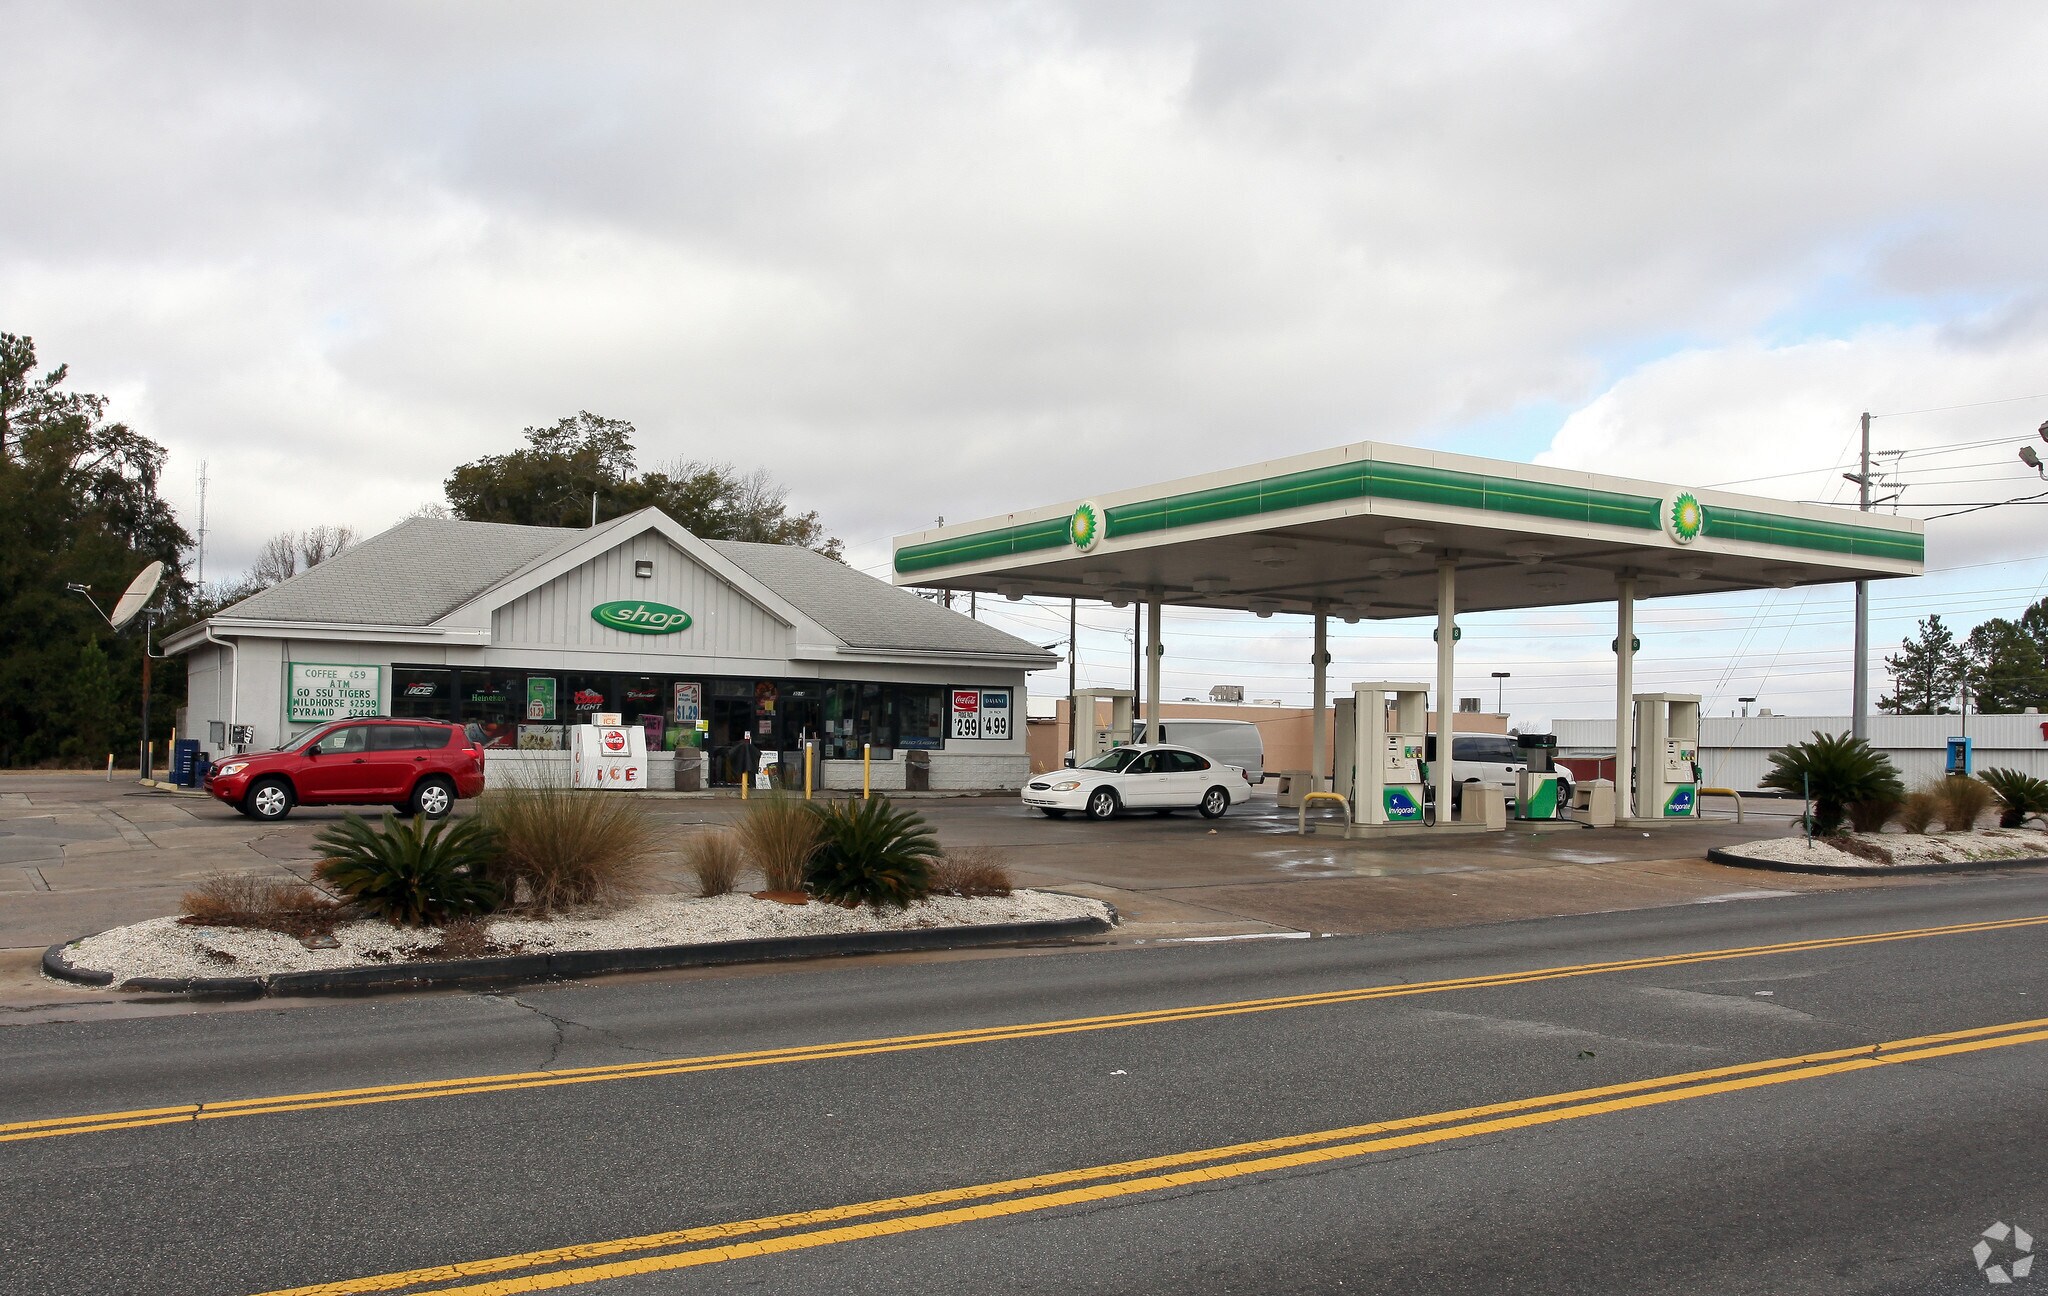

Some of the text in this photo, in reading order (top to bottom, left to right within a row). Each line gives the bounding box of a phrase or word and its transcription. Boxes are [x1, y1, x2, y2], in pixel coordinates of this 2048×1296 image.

[617, 604, 686, 631] shop
[305, 669, 338, 679] COFFEE
[329, 680, 350, 688] ATM
[297, 688, 371, 699] GO SSU TIGERS
[471, 694, 506, 702] Heineken
[293, 698, 377, 708] WILDHORSE $2599
[575, 703, 602, 711] LIGHT
[292, 707, 377, 717] PYRAMID $2449
[529, 707, 545, 717] $1.29
[677, 705, 698, 720] $1.29
[954, 718, 977, 737] $2.99
[983, 717, 1007, 735] $4.99
[244, 726, 254, 744] AIR
[597, 767, 638, 781] ICE
[1388, 806, 1416, 815] Invigorate
[1668, 803, 1690, 811] Invigorate
